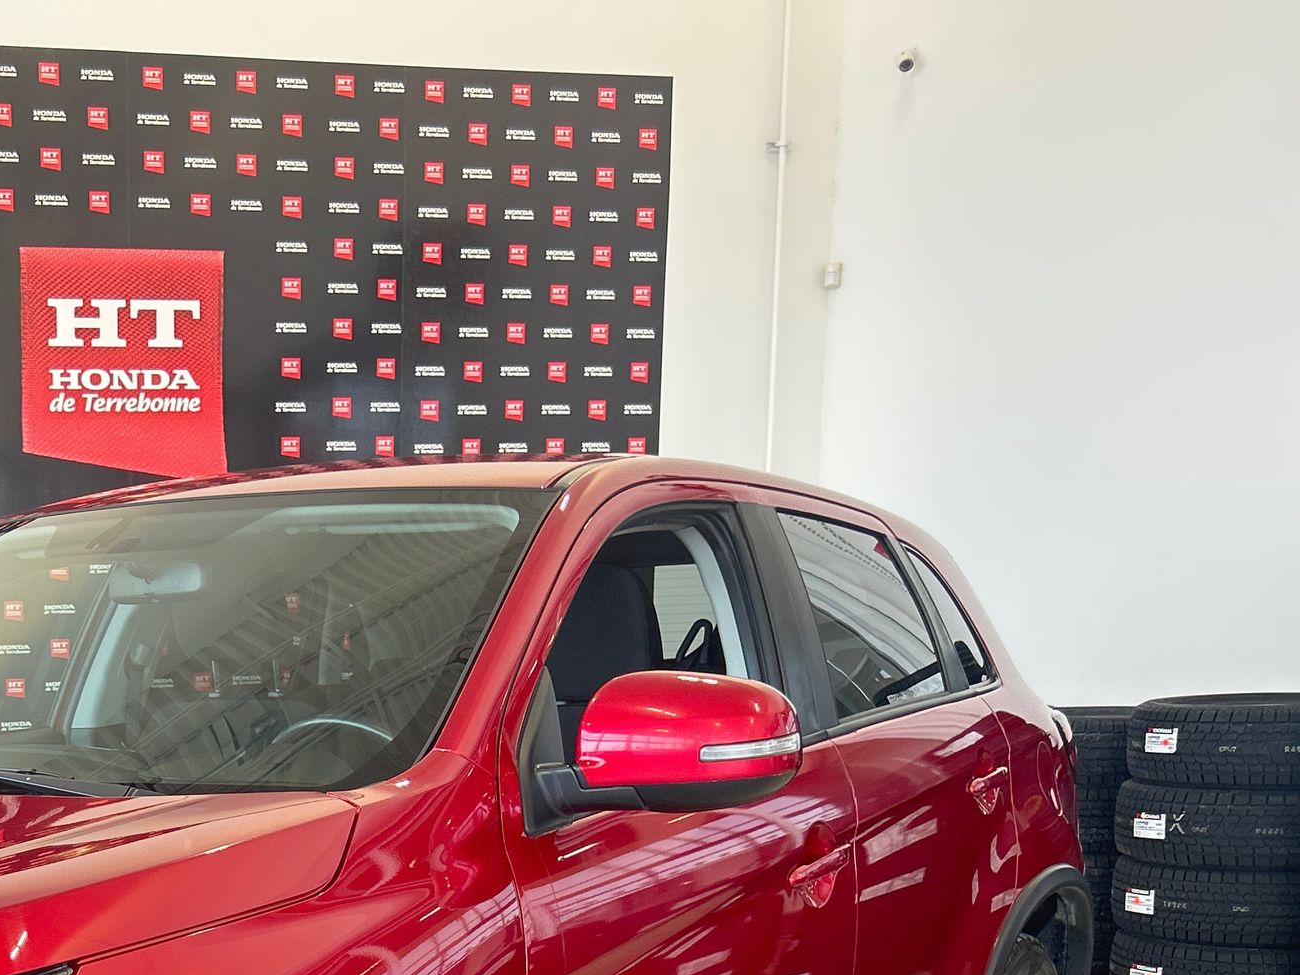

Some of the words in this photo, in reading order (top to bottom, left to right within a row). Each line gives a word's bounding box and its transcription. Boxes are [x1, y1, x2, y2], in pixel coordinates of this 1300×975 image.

[137, 113, 170, 121] HONDA
[47, 298, 200, 347] HT
[49, 369, 200, 390] HONDA
[49, 392, 76, 412] de
[81, 392, 201, 412] Terrebonne
